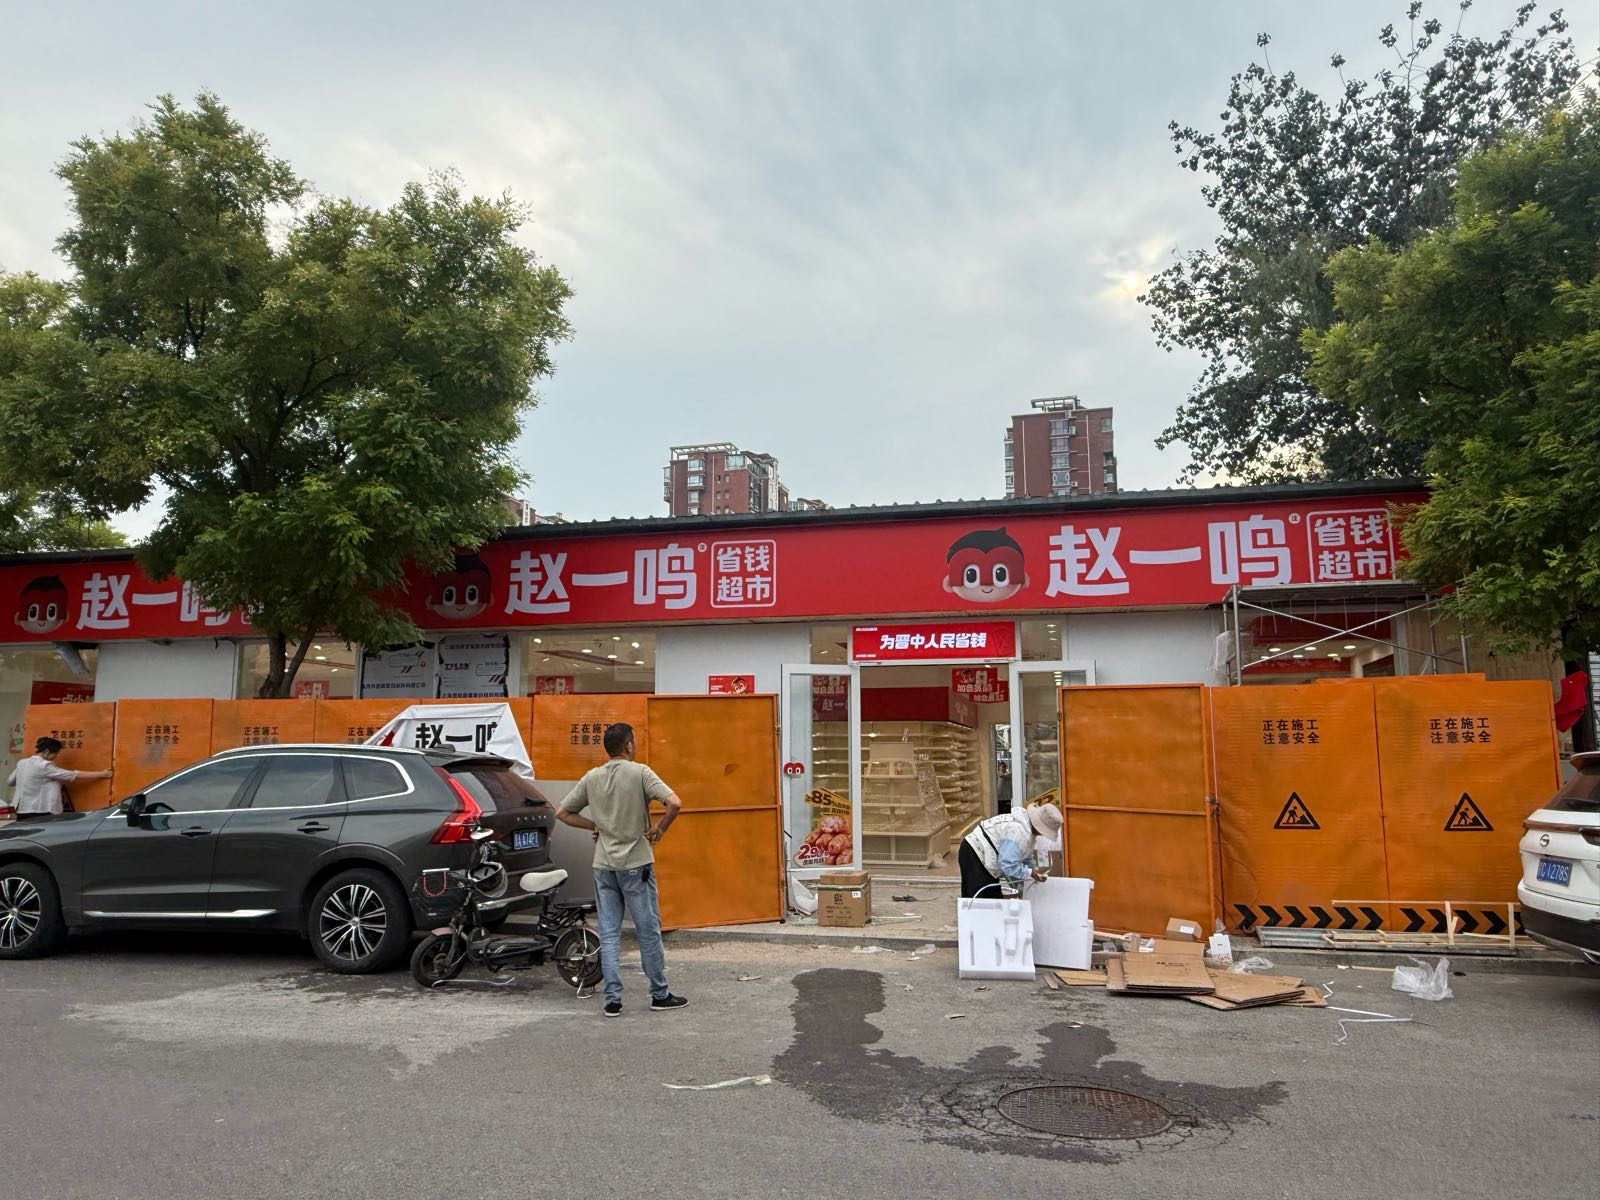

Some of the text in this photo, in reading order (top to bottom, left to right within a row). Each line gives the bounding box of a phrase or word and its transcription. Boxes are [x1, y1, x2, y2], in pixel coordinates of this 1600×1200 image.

[1314, 514, 1384, 547] 省钱
[716, 545, 770, 573] 省钱
[1045, 515, 1293, 598] 赵一鸣
[1318, 548, 1388, 580] 超市
[504, 543, 697, 615] 赵一鸣
[716, 574, 772, 602] 超市
[880, 632, 987, 650] 为晋中人民省钱
[145, 725, 180, 735] 正在施工
[243, 726, 280, 736] 正在施工
[1262, 718, 1319, 731] 正在施工
[1429, 717, 1490, 730] 正在施工
[570, 734, 601, 745] 注意安
[1263, 731, 1320, 745] 注意安全
[1430, 730, 1491, 744] 注意安全
